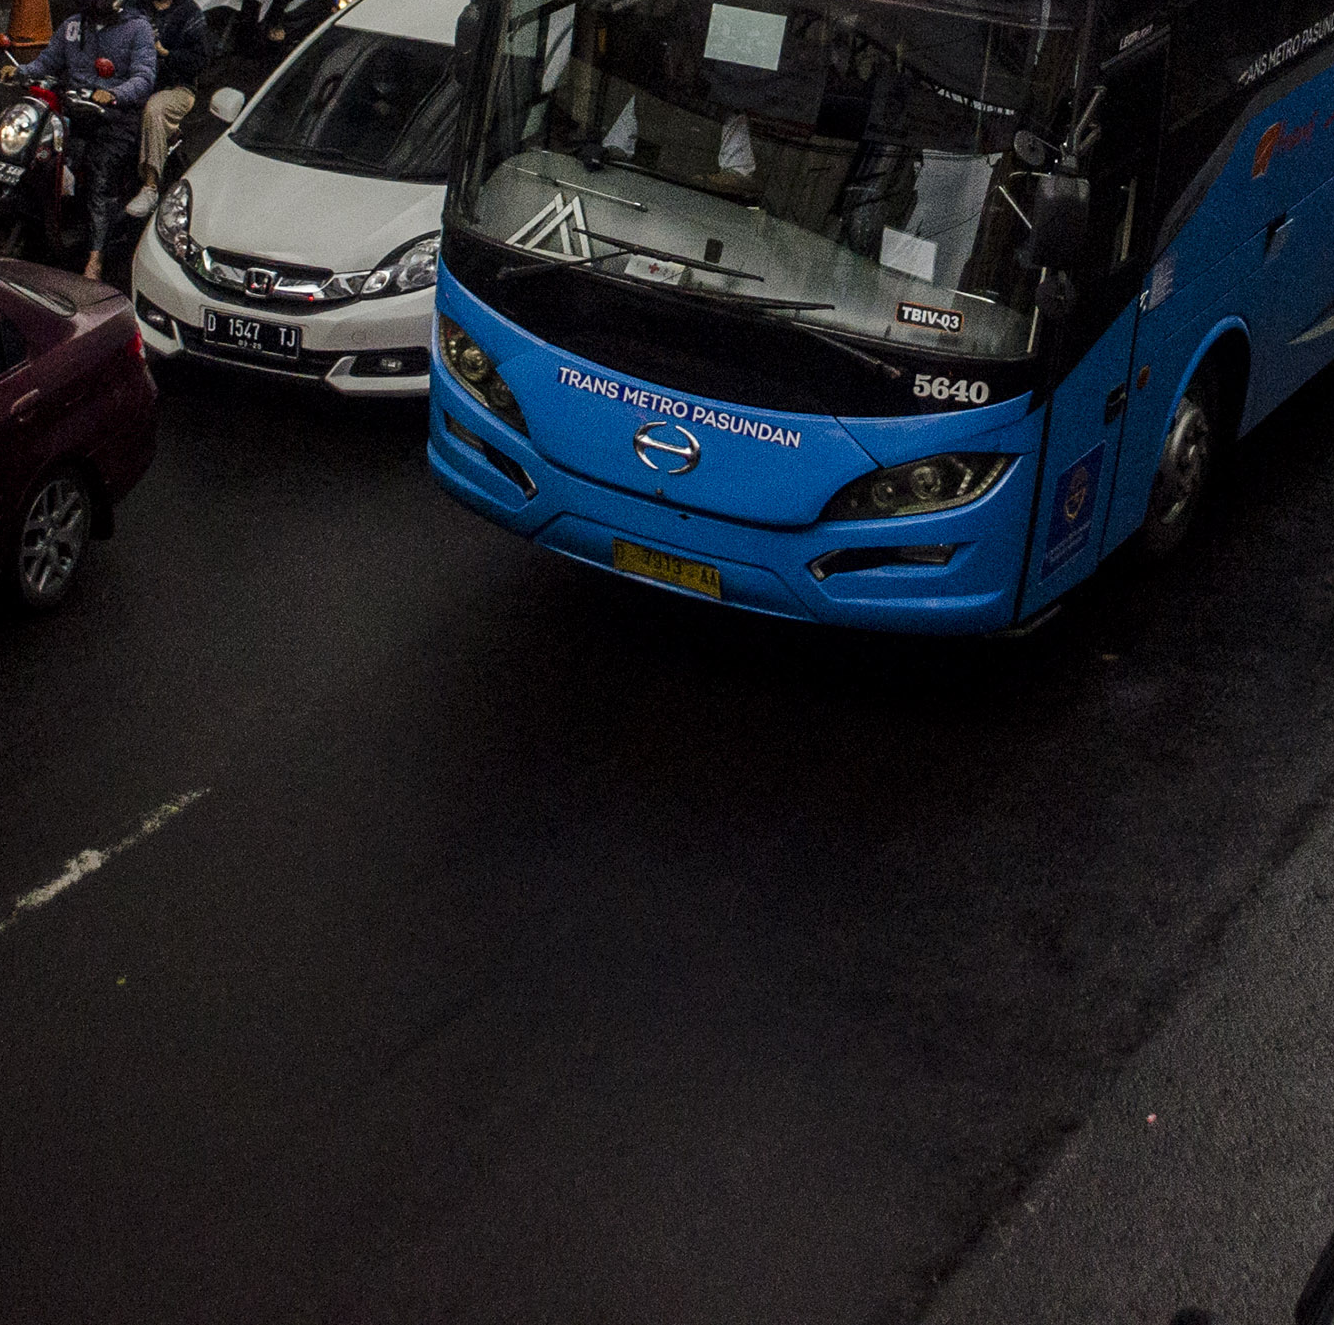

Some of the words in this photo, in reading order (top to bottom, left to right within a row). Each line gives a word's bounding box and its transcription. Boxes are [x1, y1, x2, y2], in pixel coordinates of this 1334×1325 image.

[207, 314, 217, 332] D
[228, 317, 261, 341] 1547
[278, 327, 297, 347] TJ
[901, 306, 960, 329] TBIV-03
[912, 373, 991, 405] 5640
[559, 366, 620, 400] TRANS
[622, 385, 689, 421] METRO
[691, 404, 801, 448] PASUNDAN
